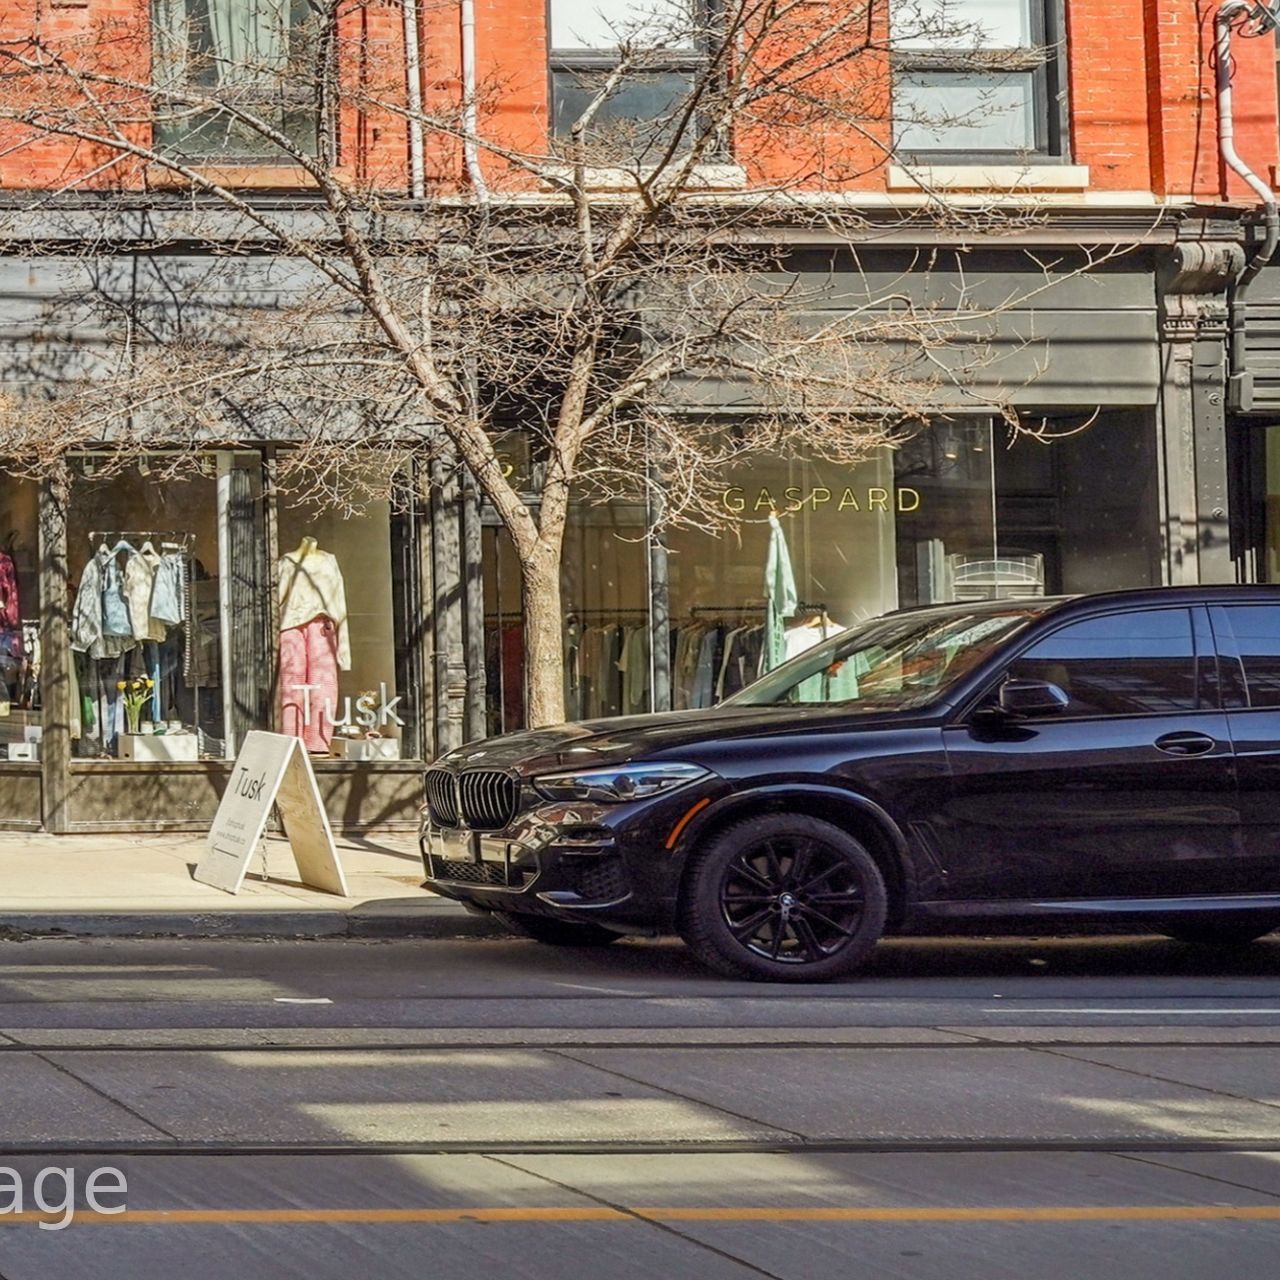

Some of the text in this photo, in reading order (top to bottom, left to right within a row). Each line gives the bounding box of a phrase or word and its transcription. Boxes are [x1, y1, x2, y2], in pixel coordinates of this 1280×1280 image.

[723, 487, 920, 513] GASPARD
[292, 682, 405, 726] Tusk
[234, 767, 267, 802] Tusk
